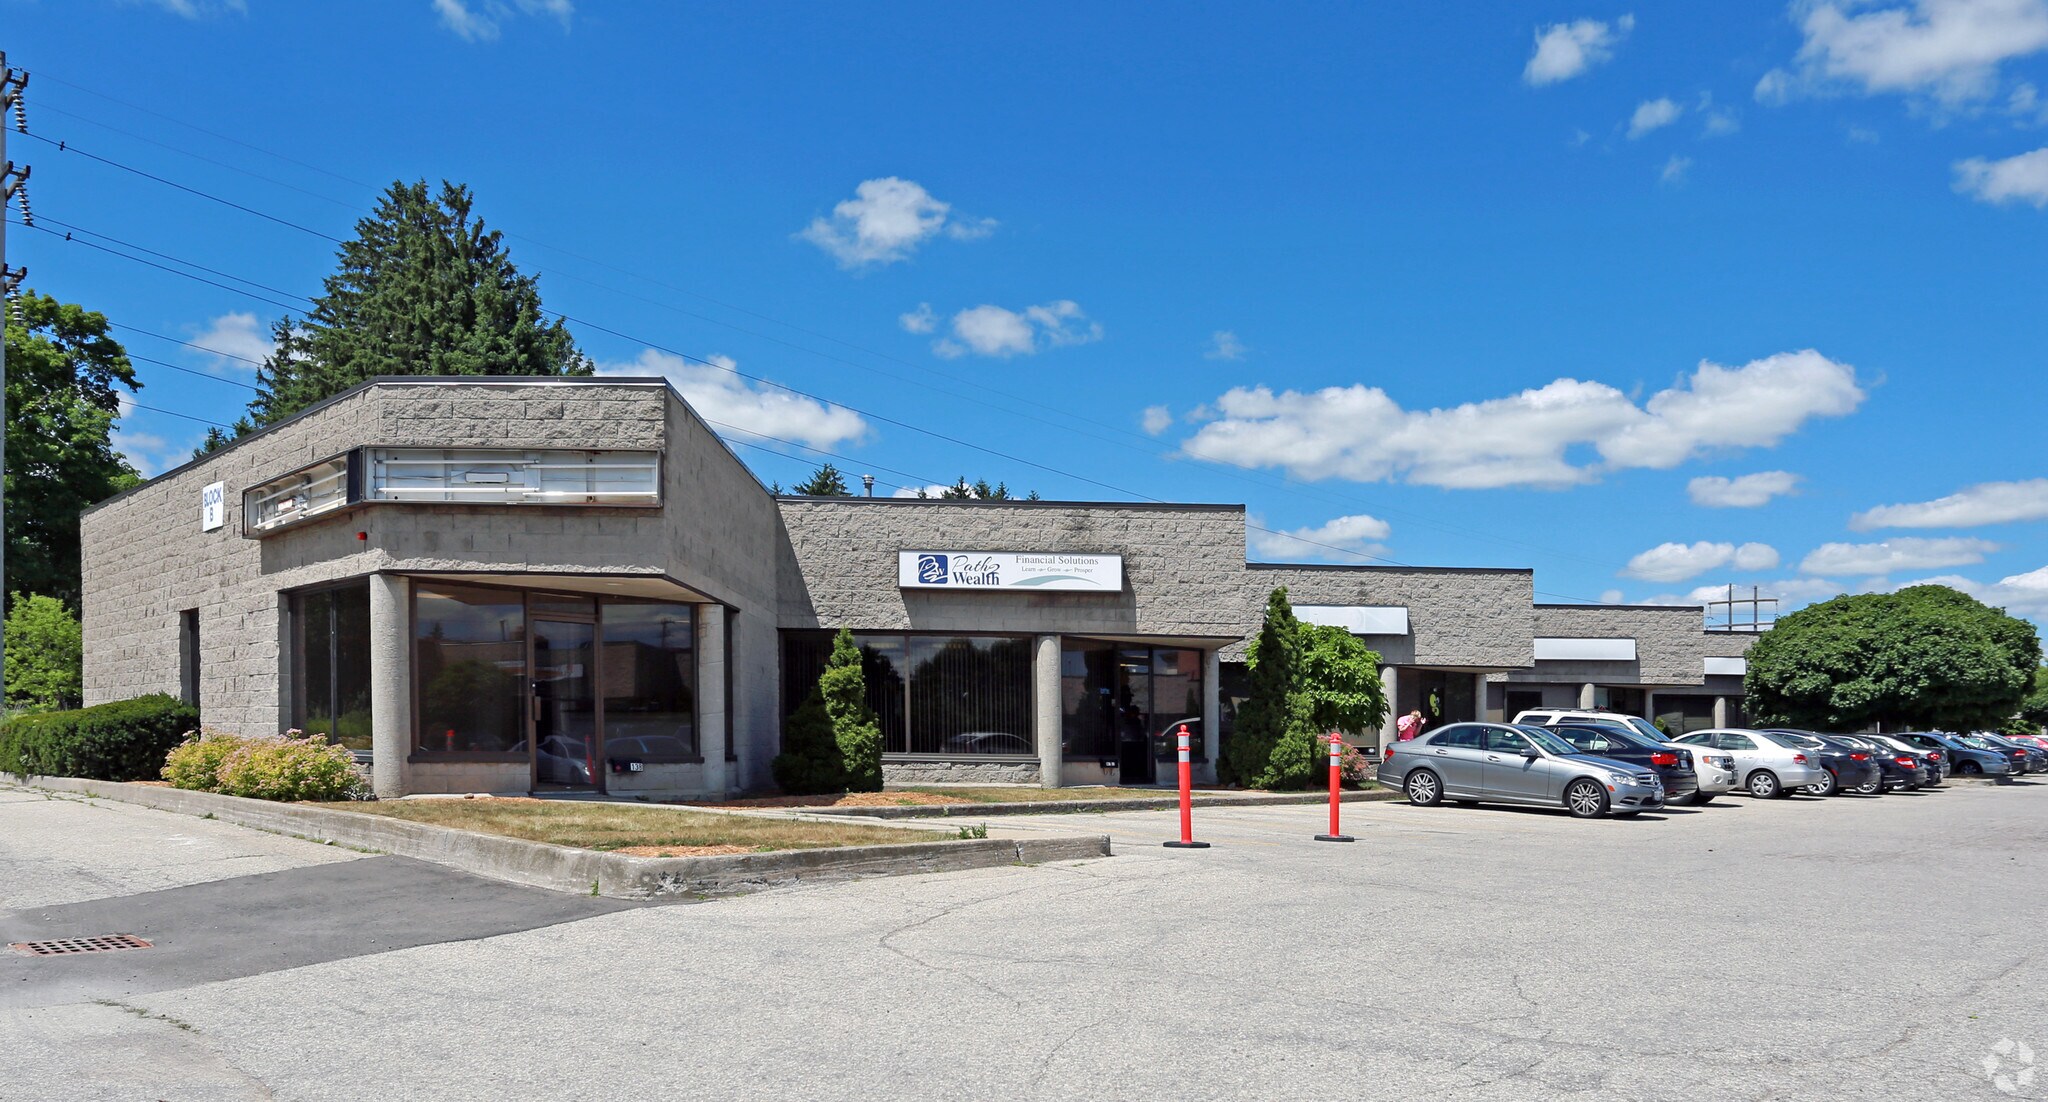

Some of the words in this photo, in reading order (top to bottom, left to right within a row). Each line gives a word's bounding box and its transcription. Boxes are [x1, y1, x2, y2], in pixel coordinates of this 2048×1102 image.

[204, 487, 222, 508] BLOCK
[210, 506, 214, 522] B
[1015, 555, 1056, 565] Financial
[1058, 556, 1099, 565] Solutions
[953, 571, 1000, 585] Wealth
